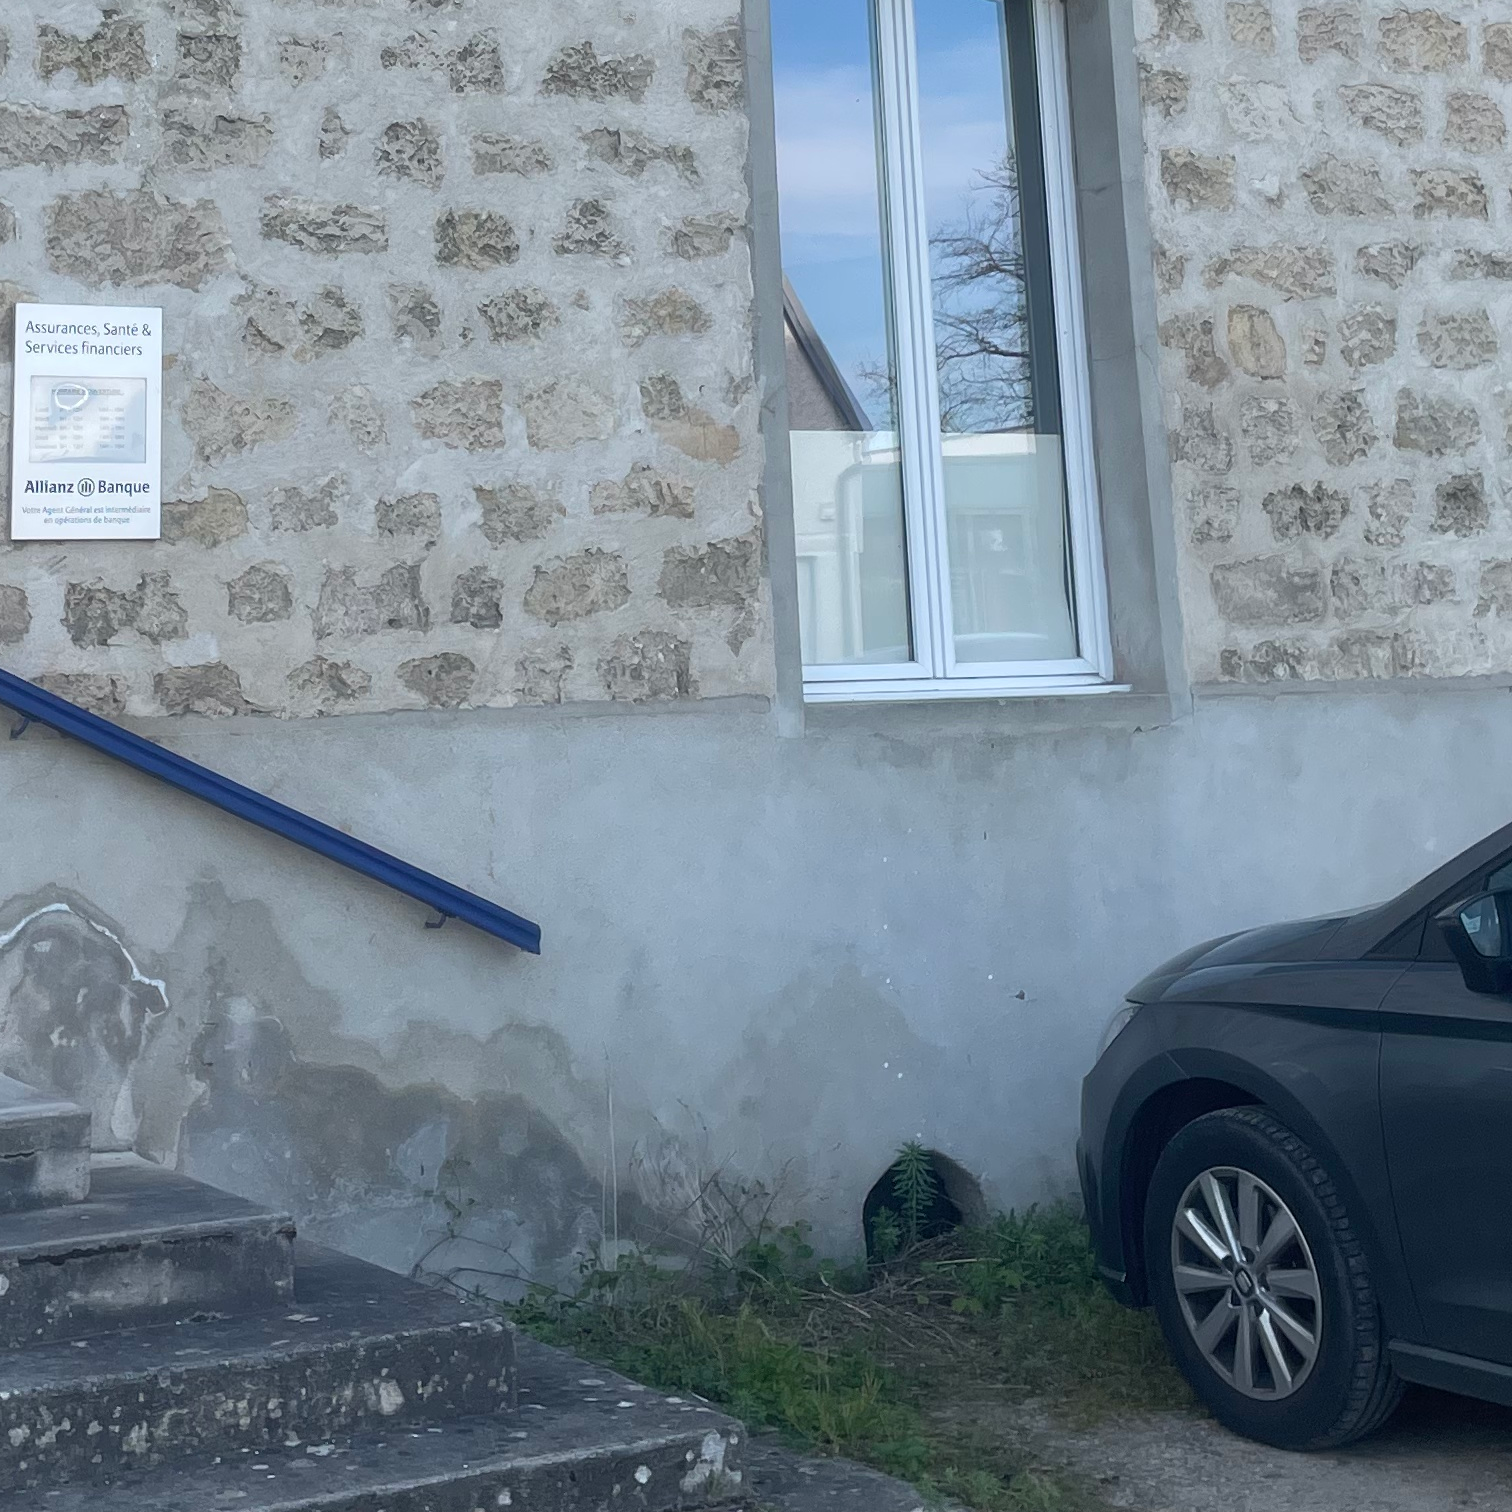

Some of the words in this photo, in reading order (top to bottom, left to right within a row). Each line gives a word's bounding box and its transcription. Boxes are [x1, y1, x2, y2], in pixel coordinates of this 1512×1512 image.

[25, 320, 101, 337] Assurances,
[103, 322, 139, 336] Santé
[141, 323, 152, 336] &
[25, 340, 78, 355] Services
[81, 340, 143, 356] financiers
[24, 479, 74, 494] Allianz
[98, 480, 150, 497] Banque
